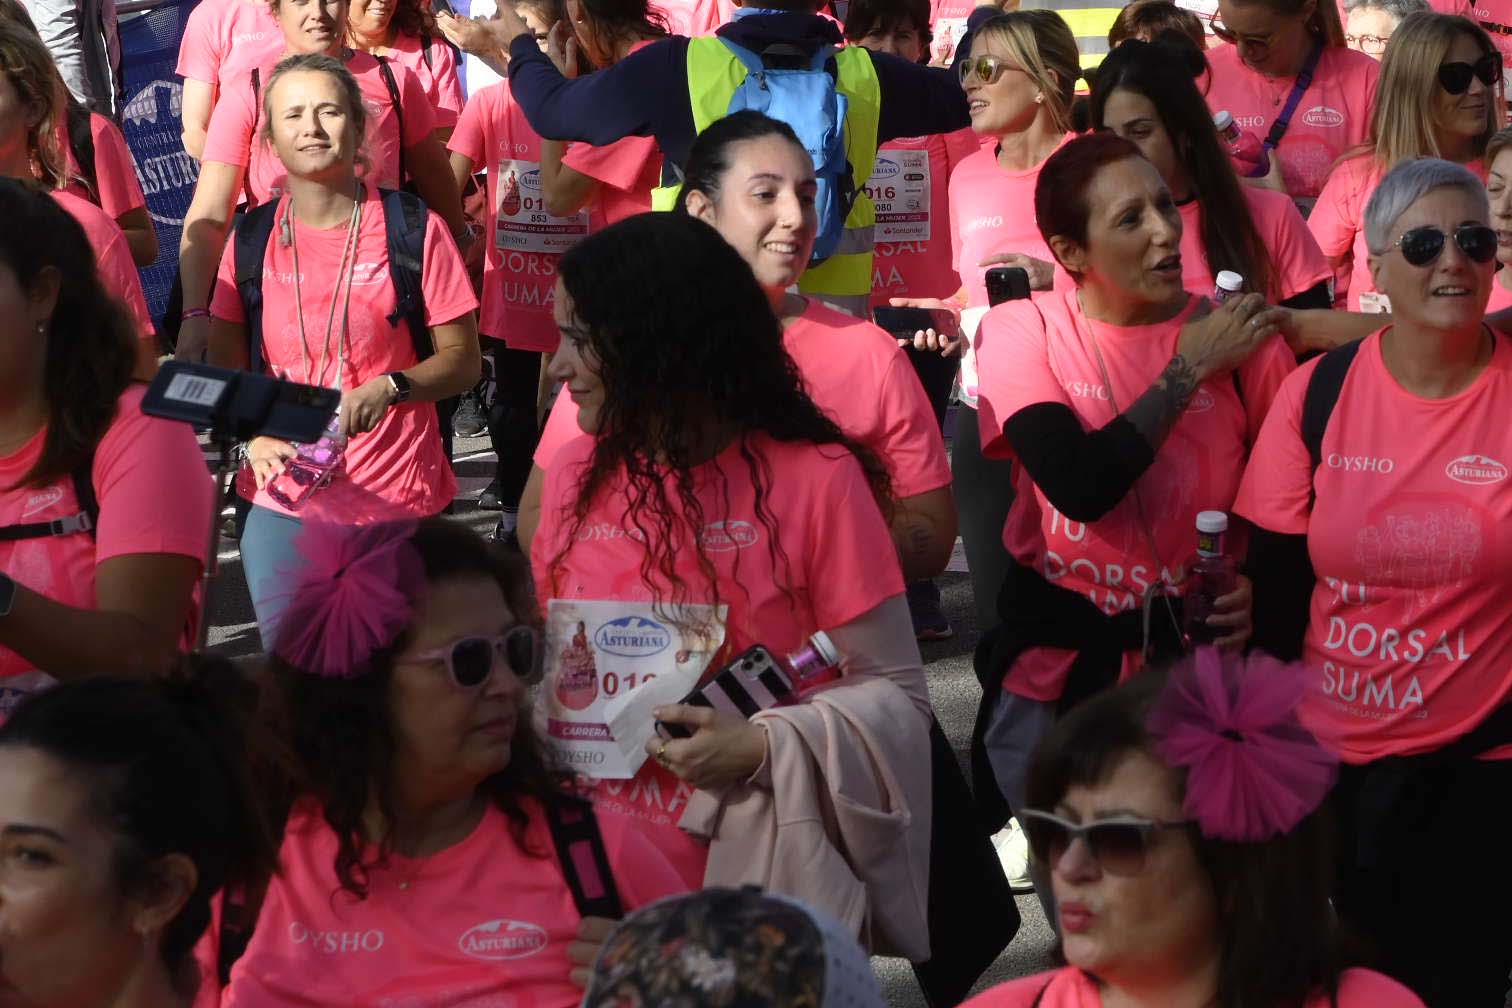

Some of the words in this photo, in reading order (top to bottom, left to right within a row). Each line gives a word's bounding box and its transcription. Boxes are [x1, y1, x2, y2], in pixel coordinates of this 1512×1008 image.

[1234, 115, 1265, 128] SHO
[522, 197, 545, 211] 01
[530, 214, 548, 224] 853
[1327, 452, 1394, 475] OYSHO
[1450, 464, 1504, 479] ASTURIANA
[600, 631, 665, 649] ASTURIANA
[1323, 616, 1472, 664] DORSAL
[1322, 660, 1424, 710] SUMA
[289, 921, 385, 953] OYSHO
[466, 934, 542, 952] ASTURIANA
